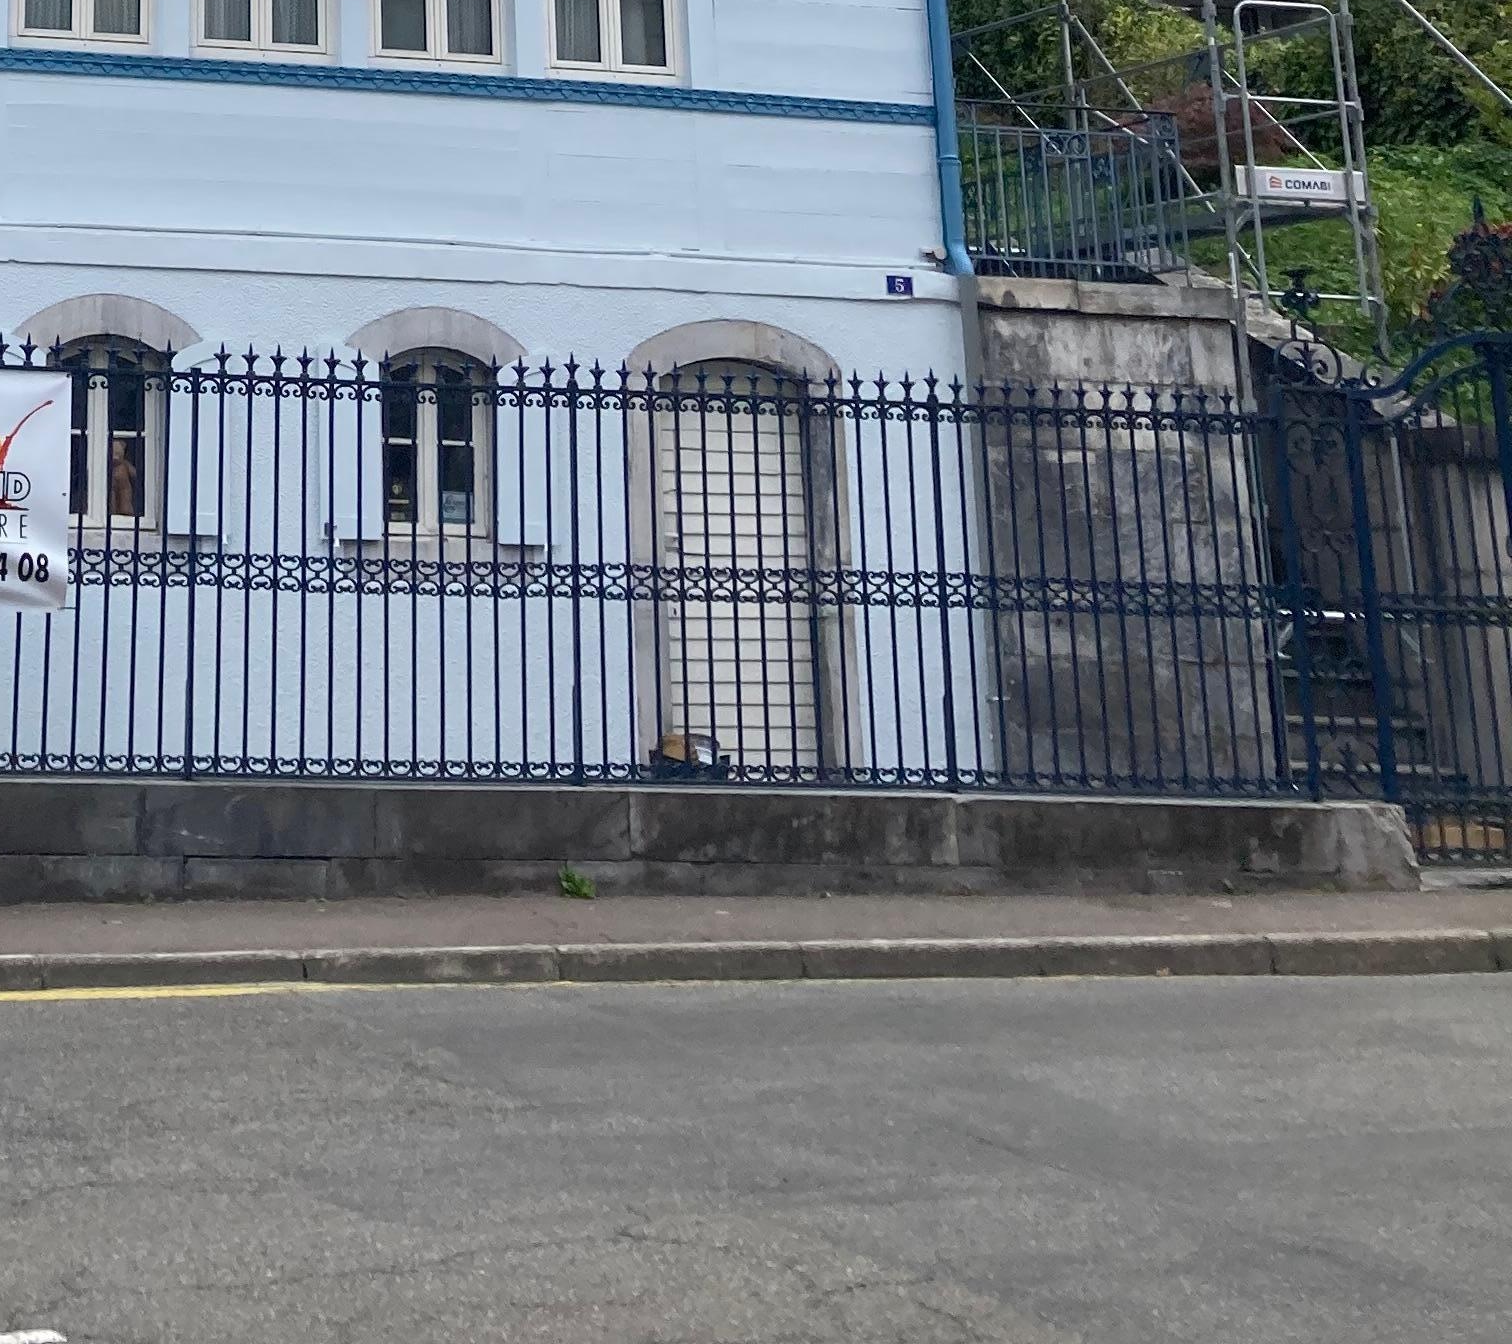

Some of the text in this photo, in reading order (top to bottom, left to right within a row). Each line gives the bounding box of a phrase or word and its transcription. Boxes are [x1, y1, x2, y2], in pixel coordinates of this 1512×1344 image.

[1285, 180, 1331, 191] COMABI
[895, 278, 905, 293] 5
[18, 552, 50, 583] 08
